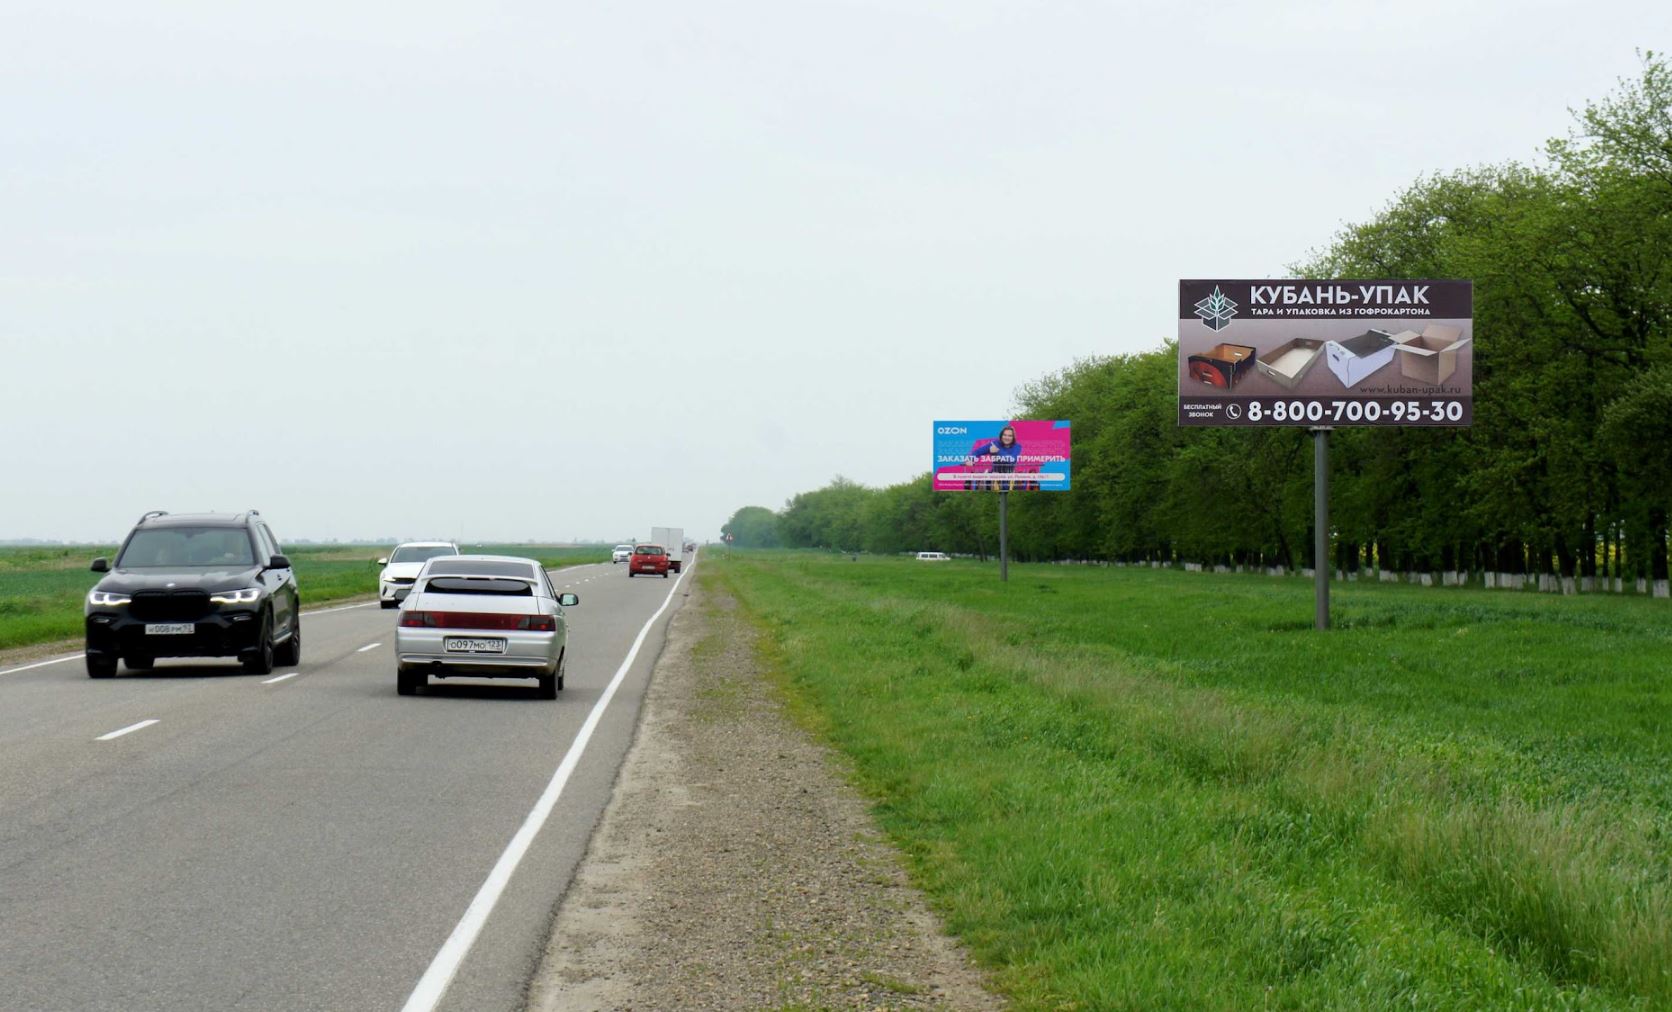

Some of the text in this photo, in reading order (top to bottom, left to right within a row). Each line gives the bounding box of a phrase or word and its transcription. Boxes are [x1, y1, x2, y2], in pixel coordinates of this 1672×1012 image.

[1250, 285, 1431, 305] КУБАНЬ-УПАК
[1251, 308, 1431, 316] ТАРА И УПАКОВКА ИЗ ГОФРОКАРТОНА
[1360, 384, 1462, 396] www.kuban-upak.ru
[1247, 401, 1463, 421] 8-800-700-95-30
[937, 427, 967, 435] OZON
[937, 455, 1066, 463] ЗАКАЗАТЬ ЗАБРАТЬ ПРИМЕРИТЬ
